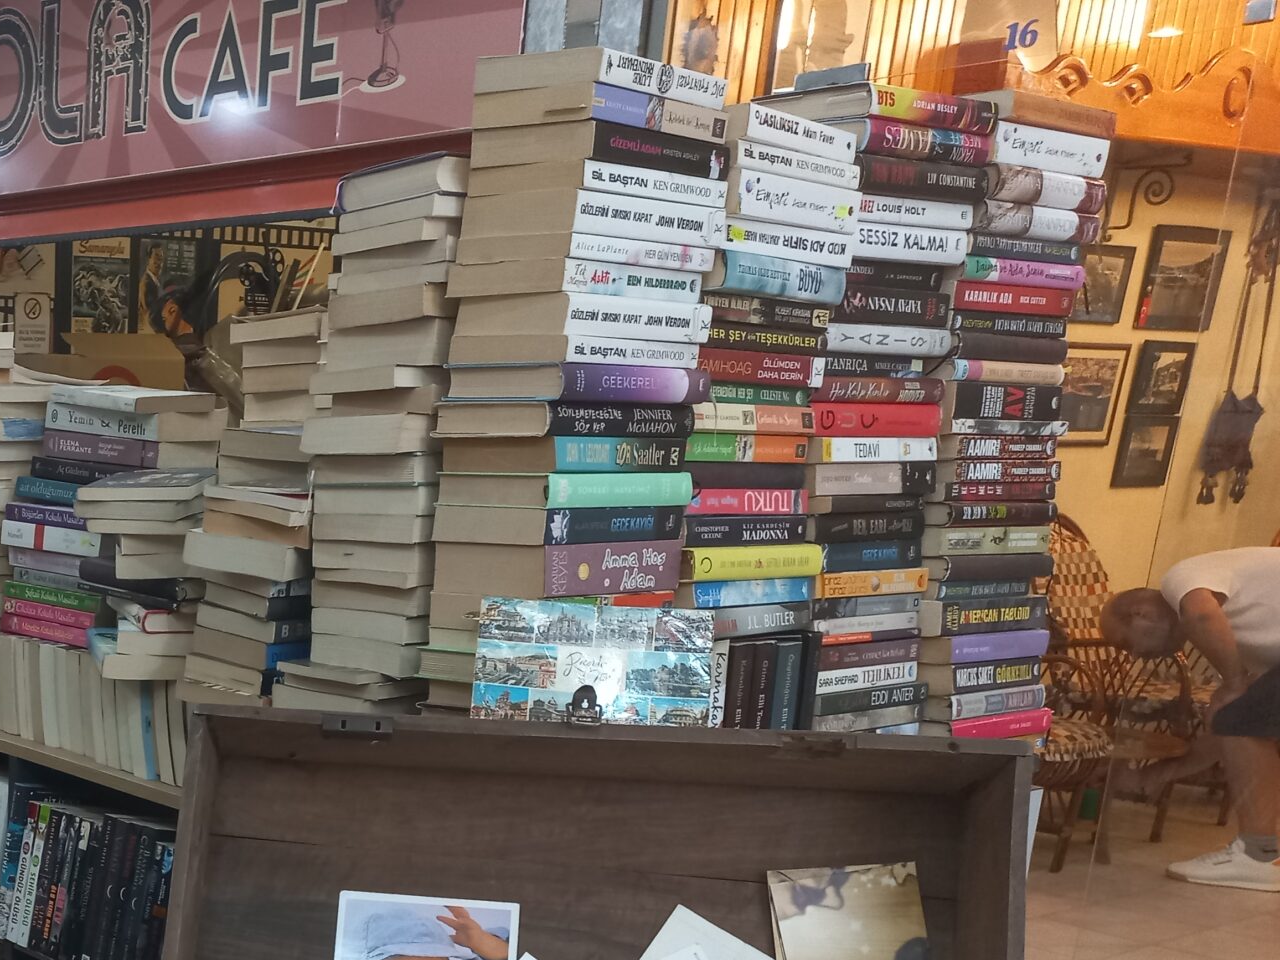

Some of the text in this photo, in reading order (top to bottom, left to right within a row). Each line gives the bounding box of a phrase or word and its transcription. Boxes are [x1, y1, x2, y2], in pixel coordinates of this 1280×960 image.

[1004, 19, 1039, 52] 16
[160, 0, 349, 123] CAFE
[877, 89, 896, 107] BTS
[913, 99, 936, 111] ADRIAN
[744, 144, 756, 160] SİL
[758, 151, 793, 168] BAŞTAN
[592, 168, 712, 198] SİL BAŞTAN KEN GRIMWOOD
[939, 173, 977, 189] CONSTANTINE
[876, 203, 927, 216] LOUIS HOLT
[633, 211, 676, 229] KAPAT JOHN
[782, 235, 809, 251] SIFIR
[859, 228, 949, 253] SESSİZ KALMA!
[828, 243, 847, 256] KOD
[798, 266, 823, 295] BÜYÜ
[964, 290, 1013, 304] KARANLIK ADA
[622, 313, 663, 327] KAPAT JOHN
[708, 328, 816, 348] HER ŞEY TEŞEKKÜRLER
[574, 342, 685, 361] SİL BAŞTAN KEN GRIMWOOD
[719, 360, 752, 375] HOAG
[763, 357, 801, 370] ÖLÜMDEN
[826, 357, 868, 375] TANRIÇA
[757, 370, 804, 381] DAHA DERİN
[558, 404, 623, 421] SÖYLEMEYECEĞİNE
[633, 408, 673, 421] JENNIFER
[574, 418, 606, 433] SÖZ VER
[626, 420, 678, 434] McMAHON
[59, 438, 80, 448] ELENA
[59, 445, 93, 455] FERRANTE
[853, 441, 881, 459] TEDAVİ
[632, 442, 665, 467] Saatler
[744, 491, 791, 512] TUTKU
[741, 529, 789, 542] MADONNA
[601, 547, 667, 572] Amma Hoş
[620, 567, 656, 592] Adam
[764, 611, 796, 628] BUTLER
[960, 605, 1031, 625] AMERICAN TABLOID
[819, 674, 859, 688] SARA SHEPARD
[890, 687, 915, 703] ANTER
[11, 857, 28, 926] GÜNDÜZ ÖLÜSÜ
